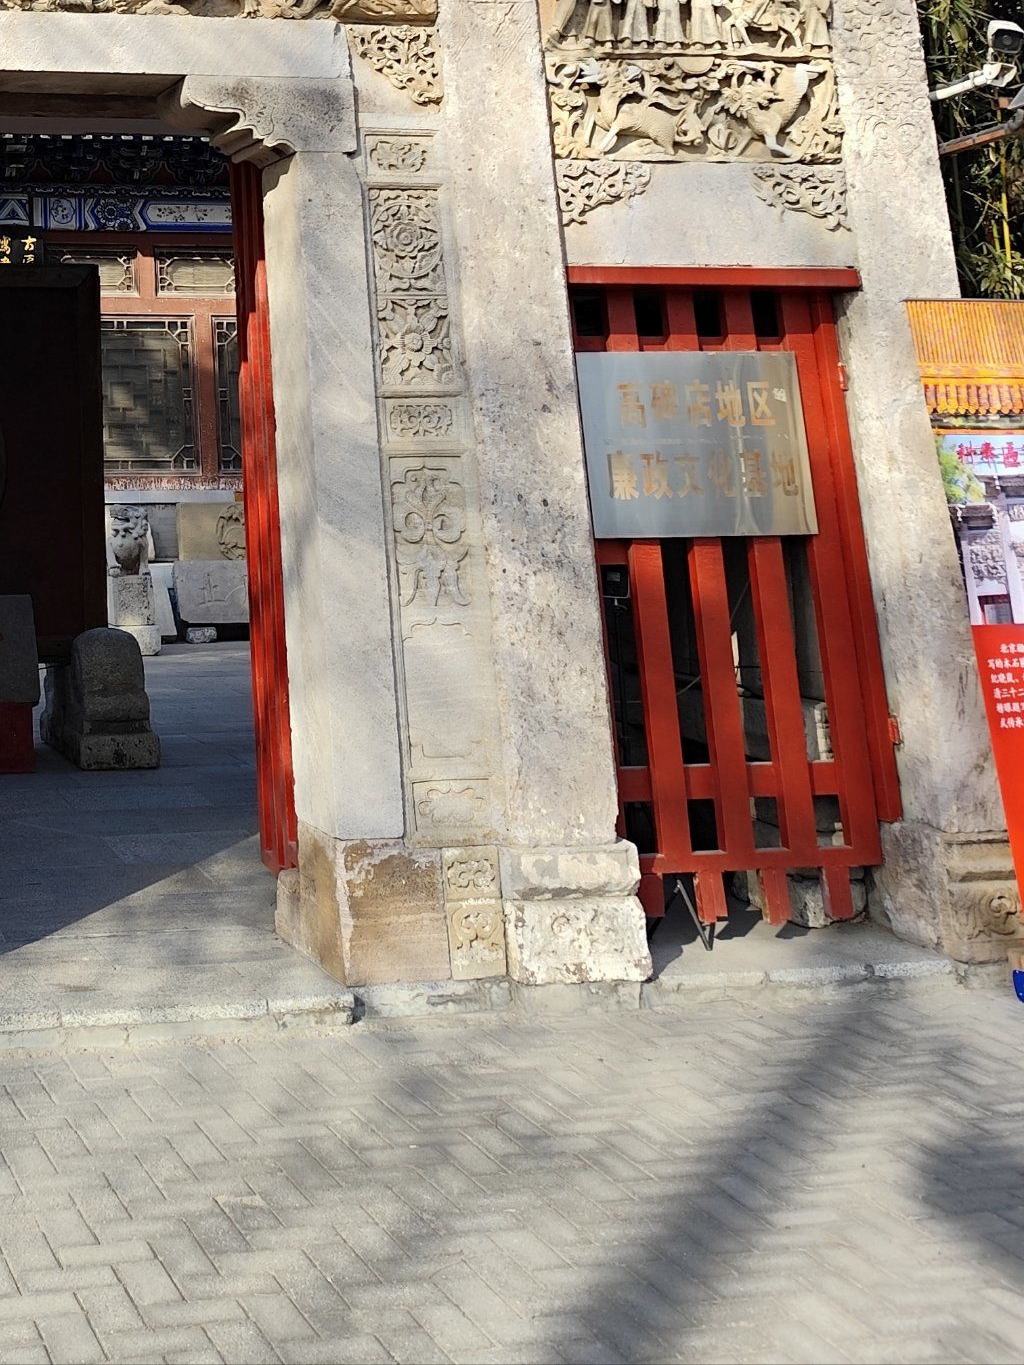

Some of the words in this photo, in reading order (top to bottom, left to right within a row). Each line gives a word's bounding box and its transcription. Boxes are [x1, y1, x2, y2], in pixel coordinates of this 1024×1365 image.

[616, 379, 775, 428] 高碑店地区
[607, 450, 799, 501] 廉政文化基地
